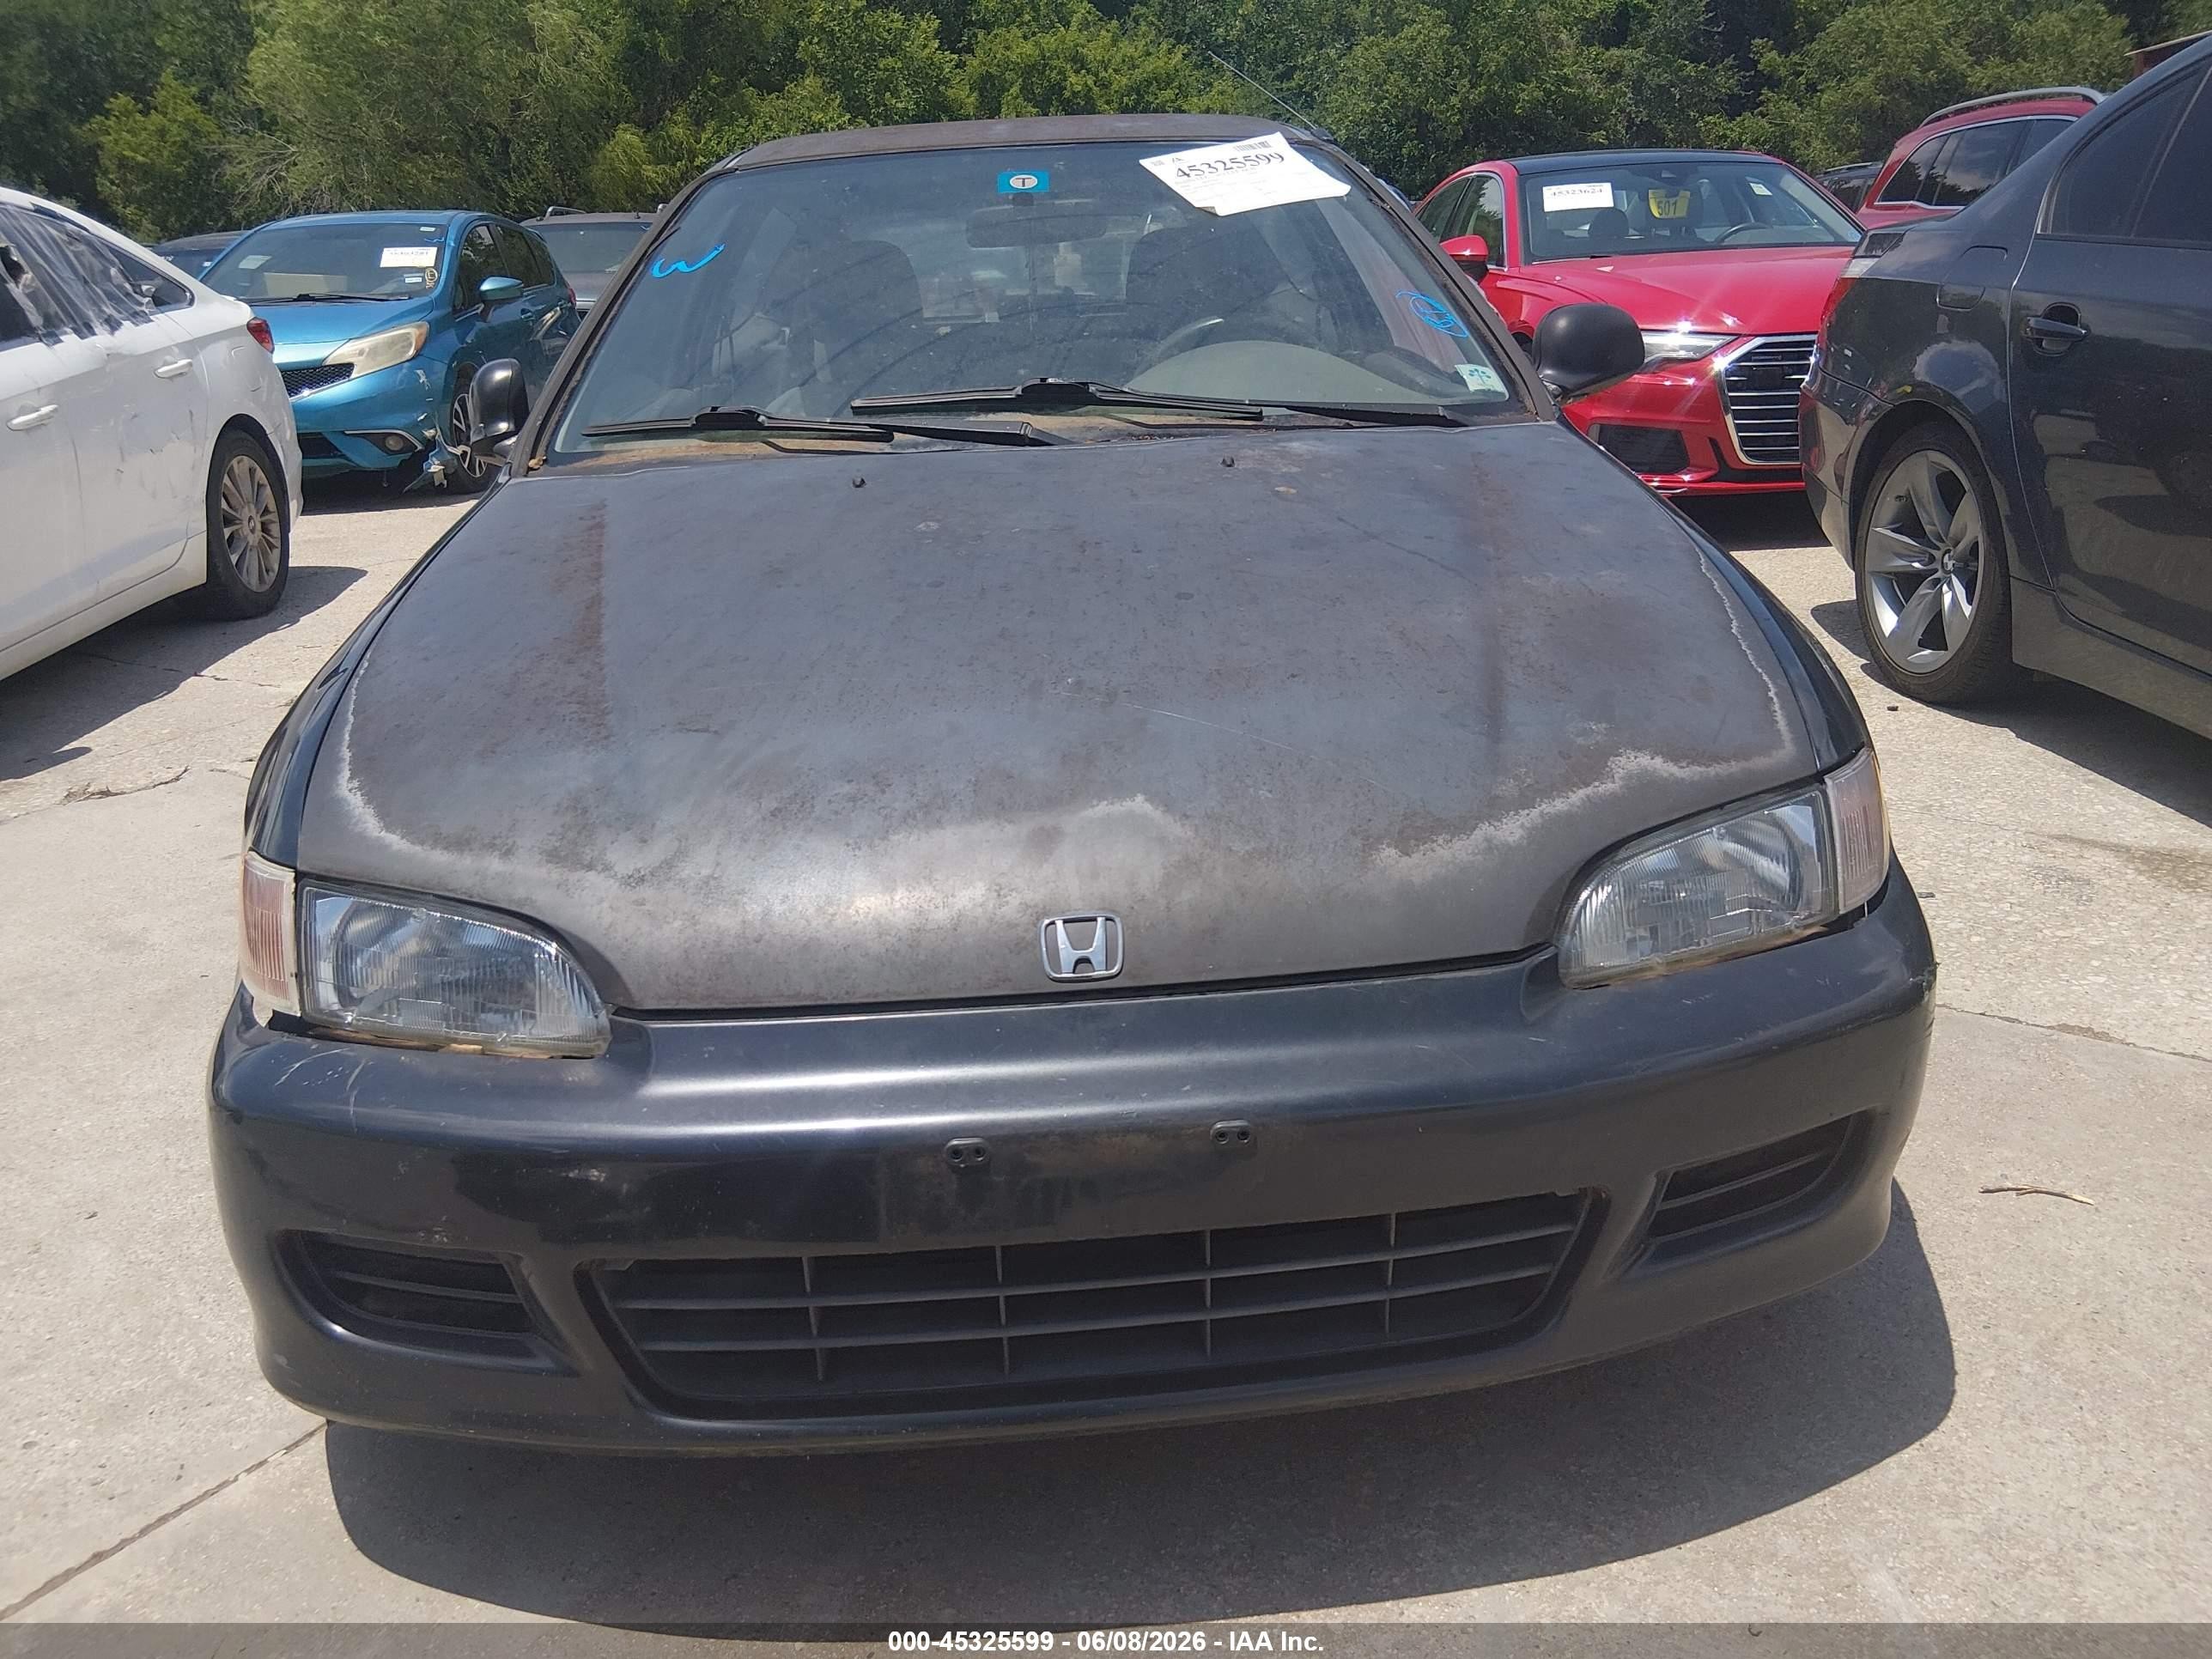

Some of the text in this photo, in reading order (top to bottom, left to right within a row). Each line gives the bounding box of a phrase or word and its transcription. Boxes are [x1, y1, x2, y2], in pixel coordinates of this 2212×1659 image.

[1176, 152, 1285, 179] 45325599
[1015, 176, 1033, 187] T
[1656, 198, 1677, 216] 501
[1054, 916, 1107, 974] H
